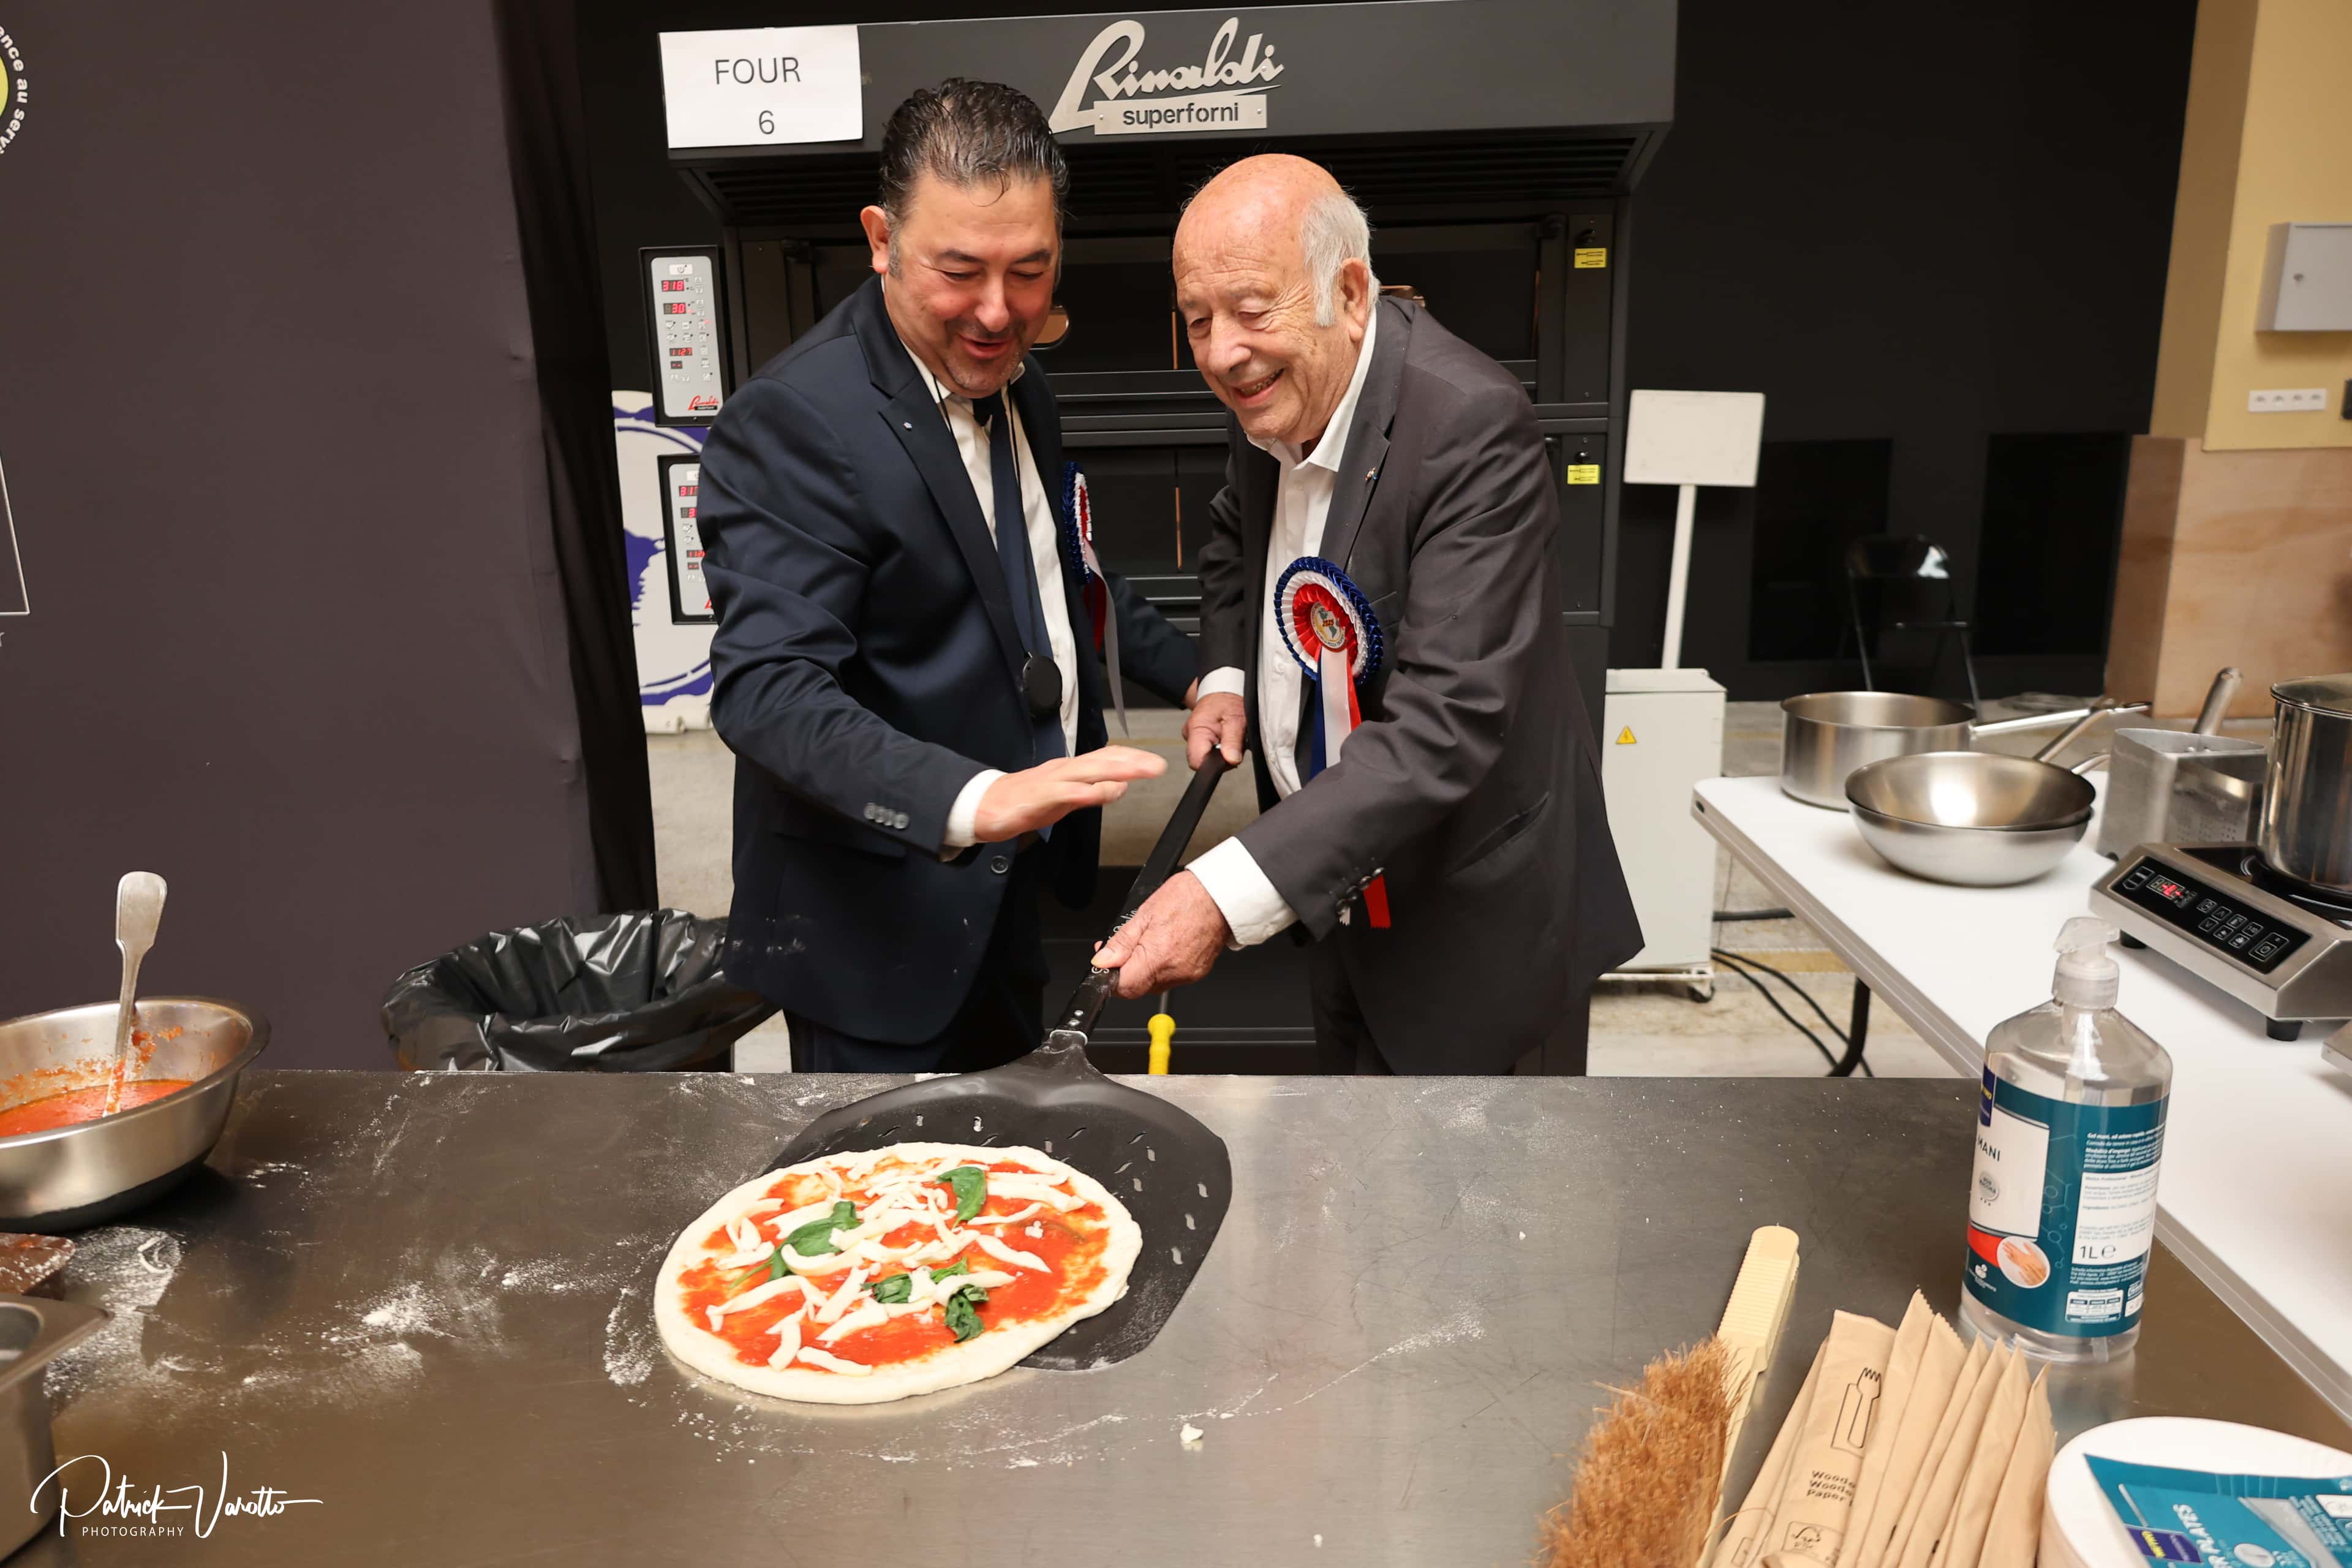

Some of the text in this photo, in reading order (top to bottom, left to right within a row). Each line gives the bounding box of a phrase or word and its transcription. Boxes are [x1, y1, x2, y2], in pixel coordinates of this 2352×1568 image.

[715, 57, 801, 85] FOUR
[1048, 17, 1284, 134] Rinaldi
[17, 78, 28, 104] au
[758, 110, 775, 135] 6
[1123, 102, 1238, 129] superforni
[672, 303, 685, 314] 30
[2079, 1245, 2098, 1259] 1L
